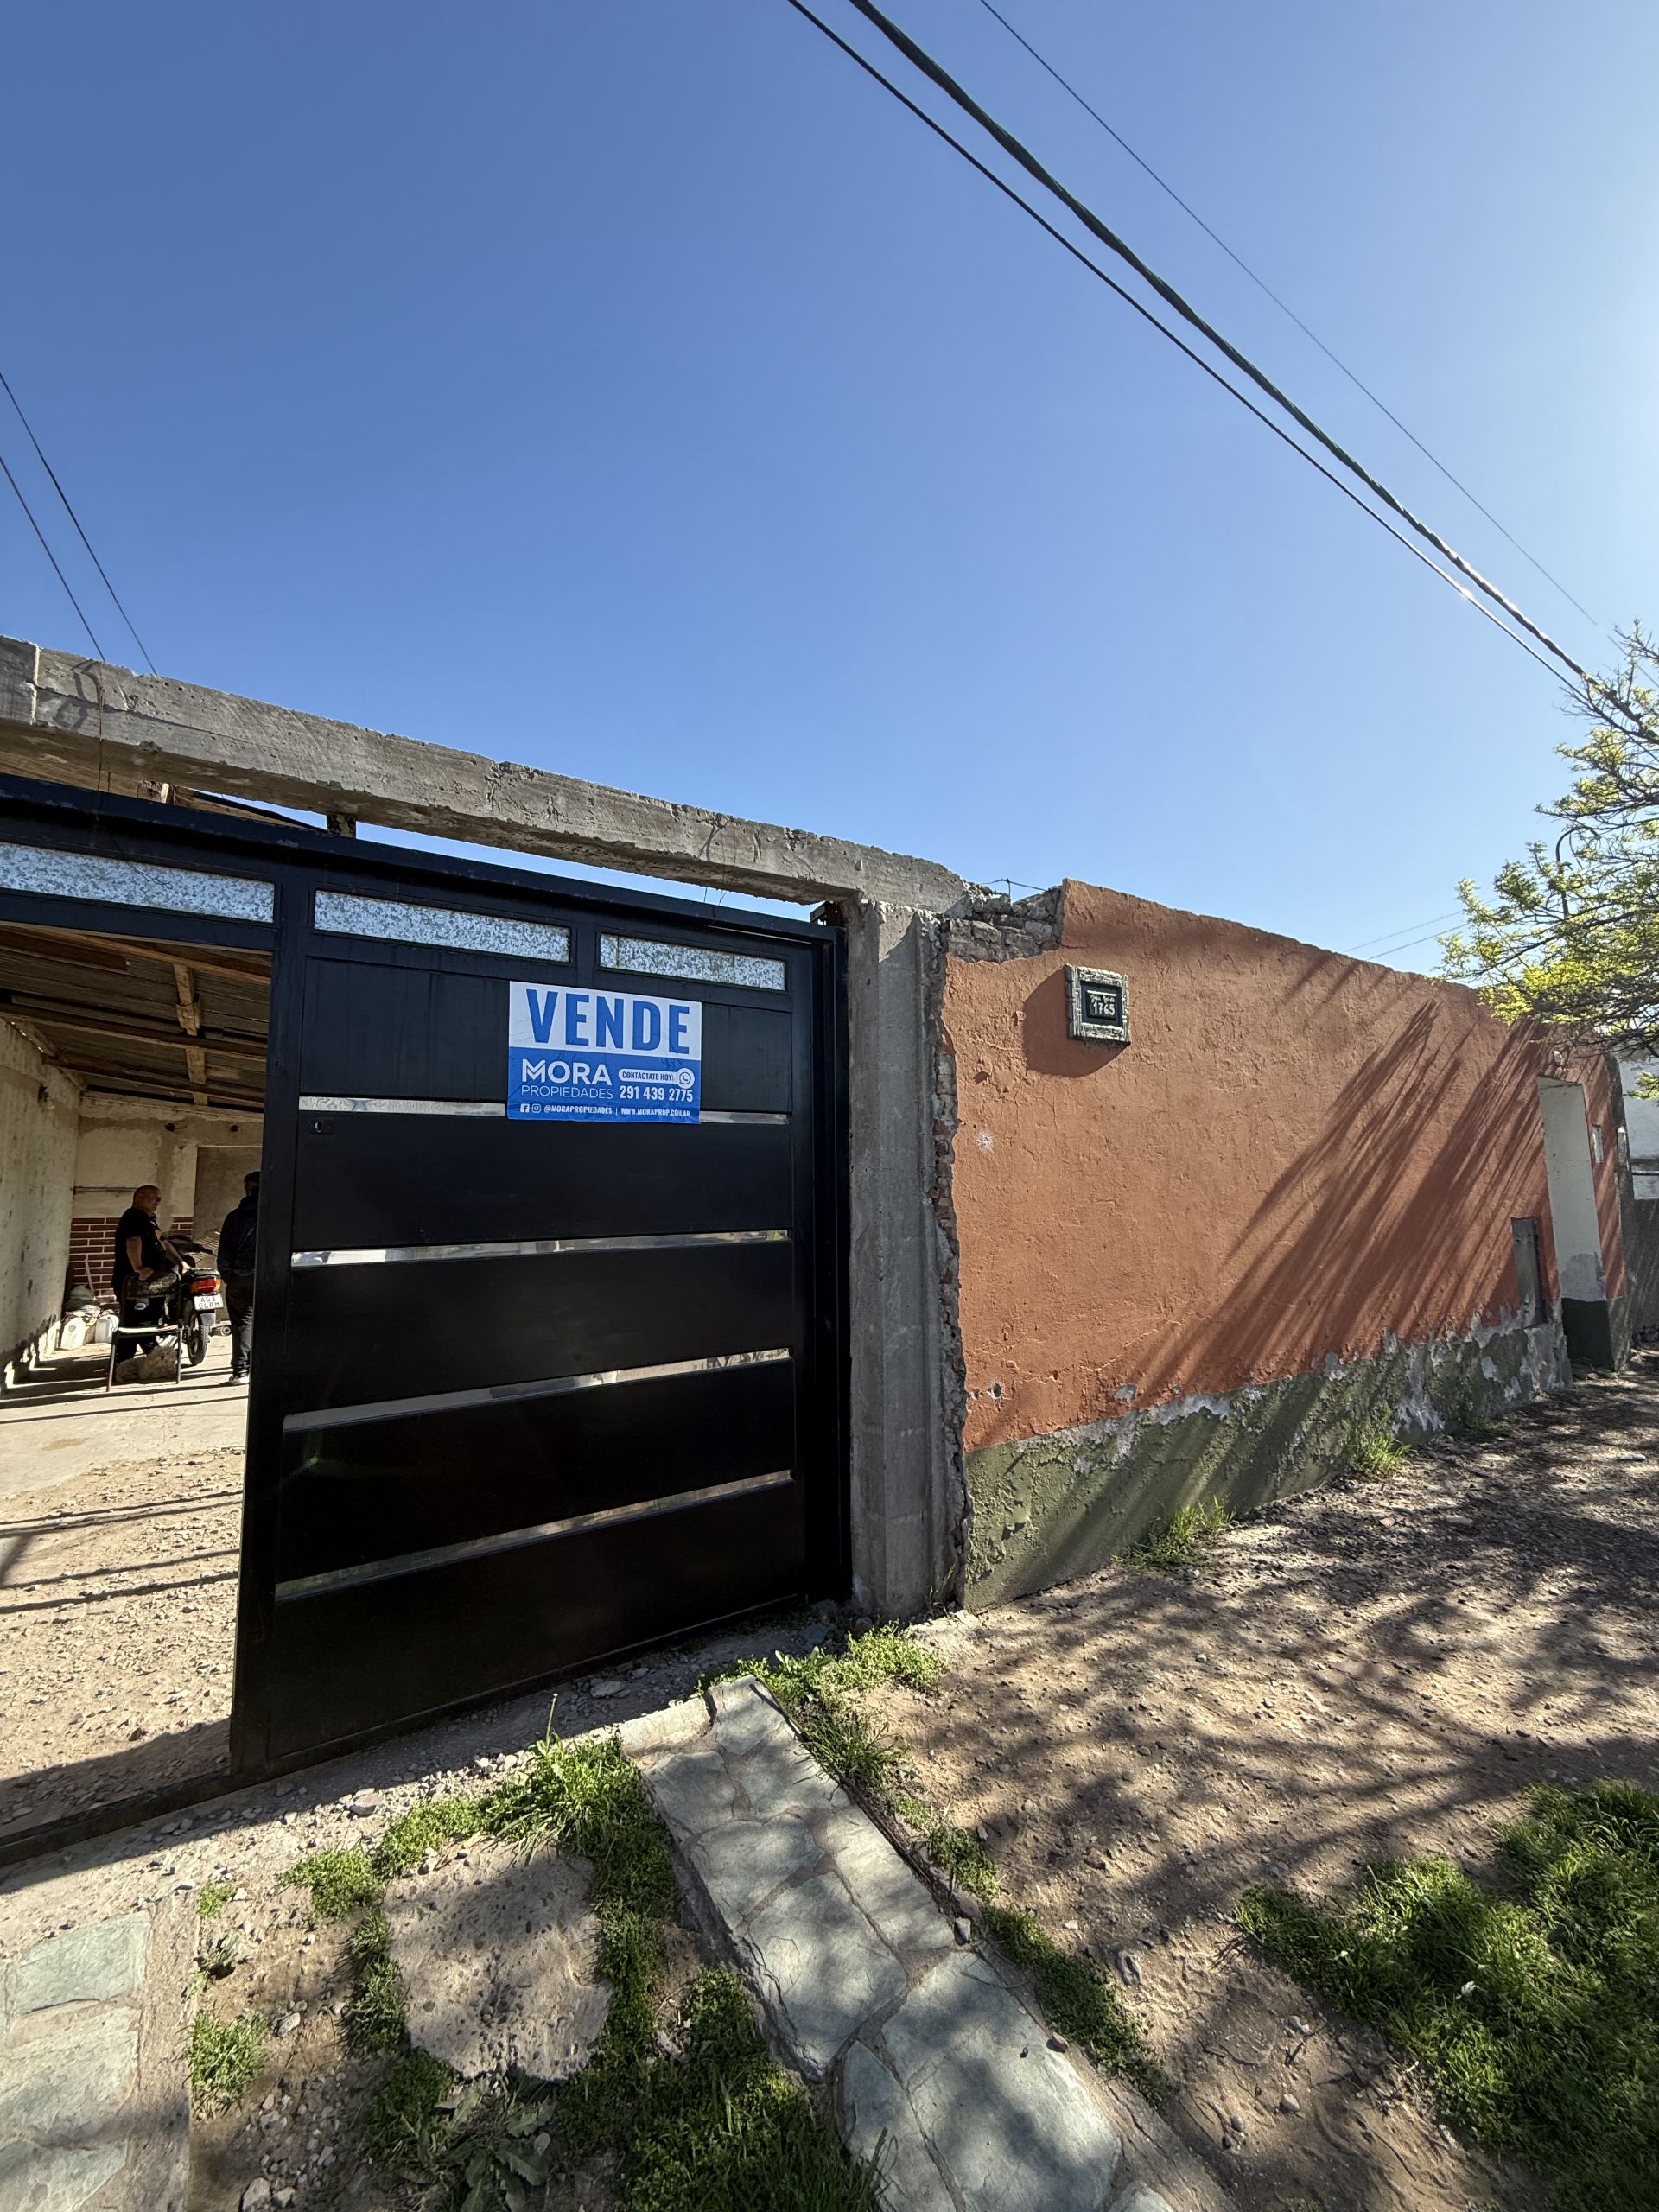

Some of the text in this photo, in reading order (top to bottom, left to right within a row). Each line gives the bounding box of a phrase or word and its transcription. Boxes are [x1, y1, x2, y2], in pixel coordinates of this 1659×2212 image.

[1093, 1001, 1116, 1016] 1765
[526, 988, 690, 1054] VENDE
[522, 1058, 613, 1086] MORA
[622, 1071, 658, 1081] CONTACTATE
[521, 1085, 613, 1100] PROPIEDADES
[619, 1085, 694, 1103] 291 439 2775
[543, 1104, 613, 1115] @MORAPROPIEDADES
